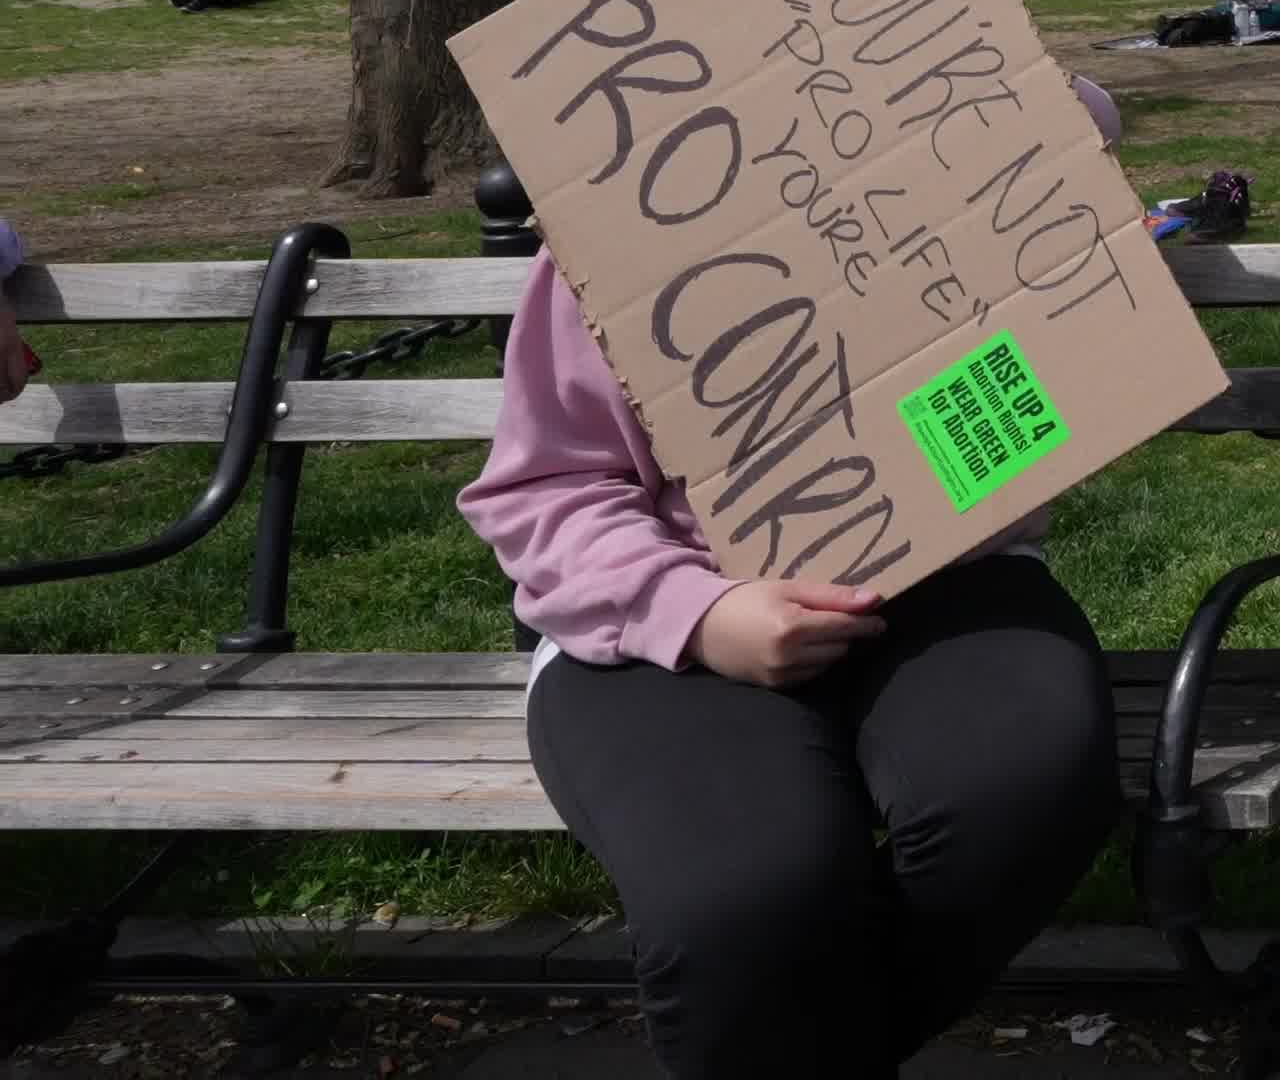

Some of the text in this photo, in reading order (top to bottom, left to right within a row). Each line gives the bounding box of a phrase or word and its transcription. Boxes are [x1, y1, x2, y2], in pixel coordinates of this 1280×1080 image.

[966, 143, 1136, 321] NOT
[928, 388, 952, 415] for
[942, 414, 990, 482] Abortion
[948, 376, 1010, 468] WEAR GREEN
[968, 360, 1033, 455] Abortion Rights!
[984, 343, 1056, 442] RISE UP 4
